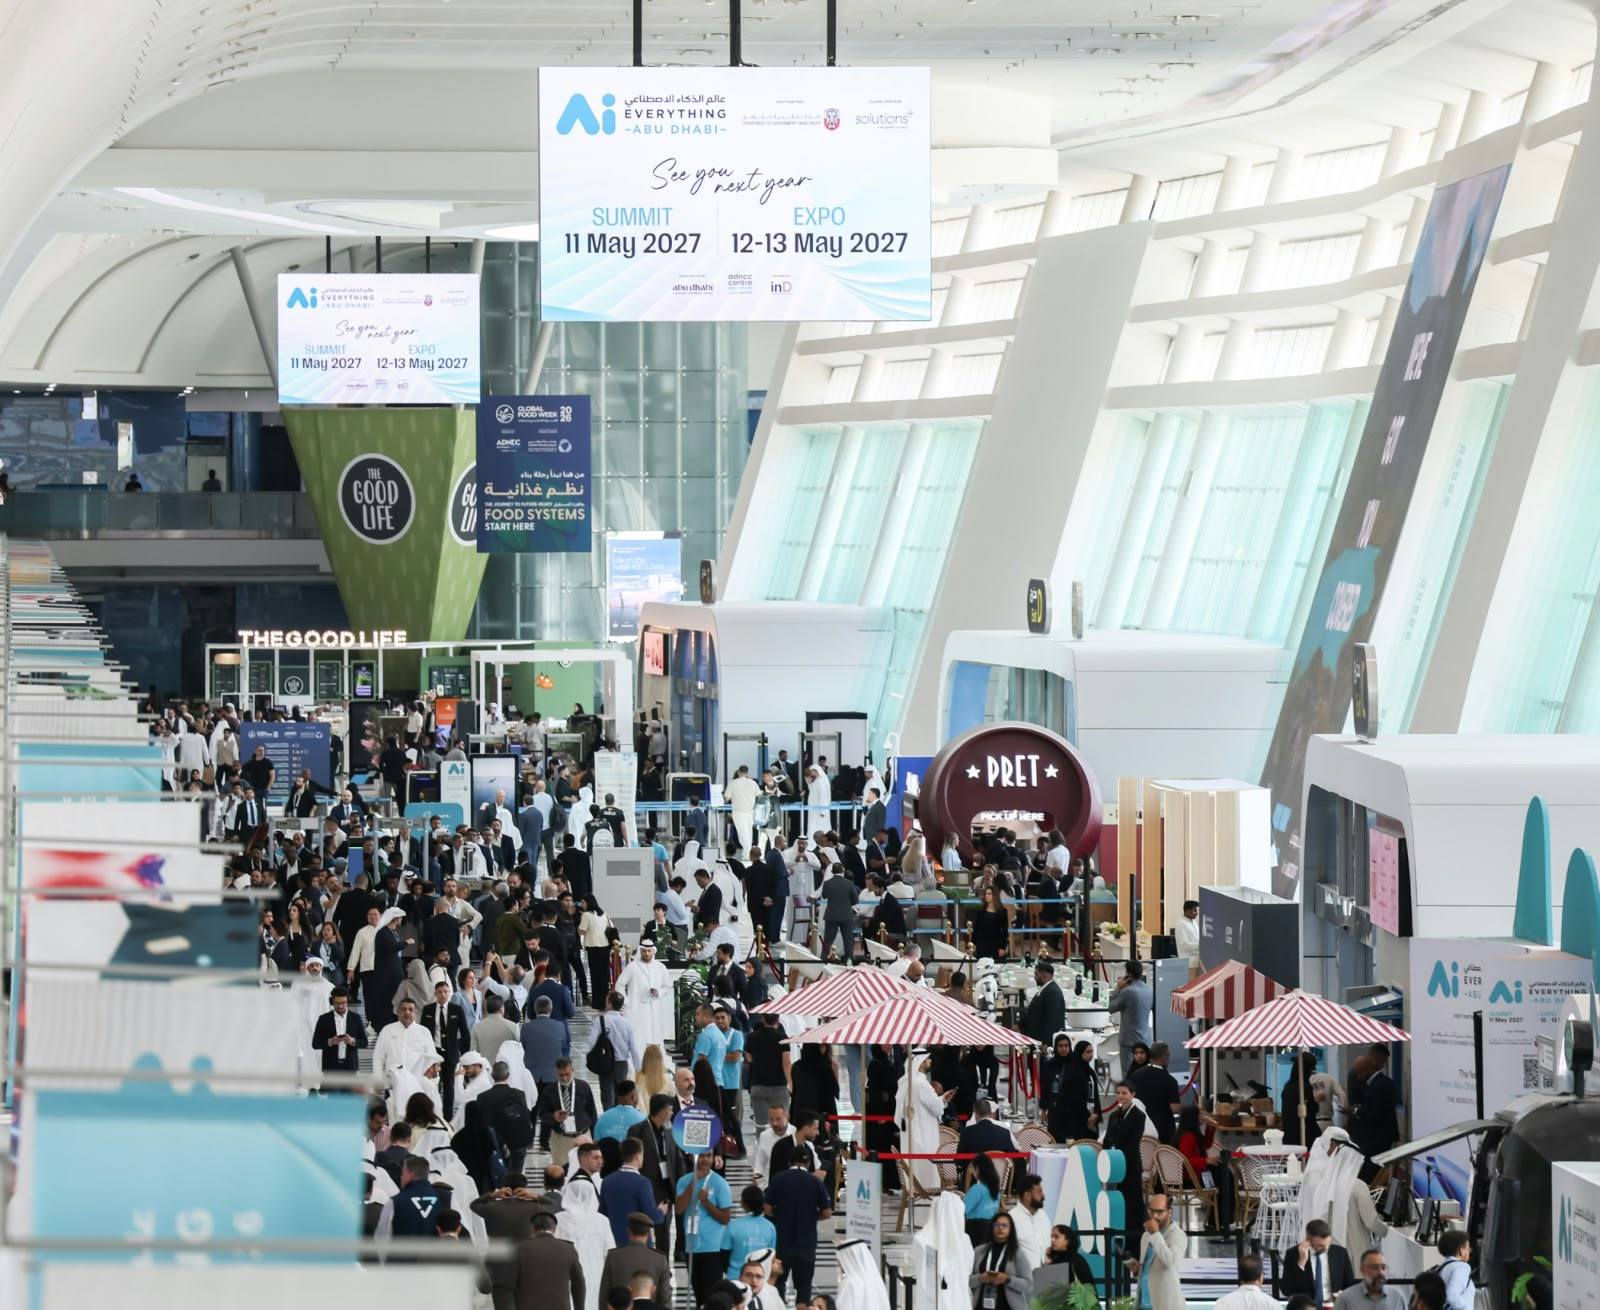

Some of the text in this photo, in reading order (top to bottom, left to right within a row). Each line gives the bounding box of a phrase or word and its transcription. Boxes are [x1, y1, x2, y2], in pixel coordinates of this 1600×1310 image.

[624, 94, 726, 107] عالم الذكاء الاصطناعي
[556, 93, 616, 135] Ai
[624, 109, 727, 118] EVERYTHING
[651, 157, 734, 195] See you
[714, 167, 812, 205] next year
[592, 206, 672, 226] SUMMIT
[794, 206, 845, 226] EXPO
[565, 232, 701, 258] 11 May 2027
[732, 232, 908, 258] 12-13 May 2027
[286, 287, 318, 309] Ai
[304, 344, 347, 355] SUMMIT
[408, 344, 436, 355] EXPO
[291, 358, 362, 371] 11 May 2027
[377, 358, 468, 371] 12-13 May 2027
[367, 468, 382, 480] THE
[352, 480, 399, 505] GOOD
[362, 504, 394, 530] LIFE
[484, 508, 585, 520] FOOD SYSTEMS
[484, 522, 535, 531] START HERE
[238, 630, 408, 648] THE GOOD LIFE
[986, 754, 1040, 788] PRET
[980, 812, 1045, 822] PICK UP HERE
[1428, 960, 1459, 998] Ai
[1488, 980, 1522, 1004] Ai
[1056, 1145, 1122, 1256] Ai
